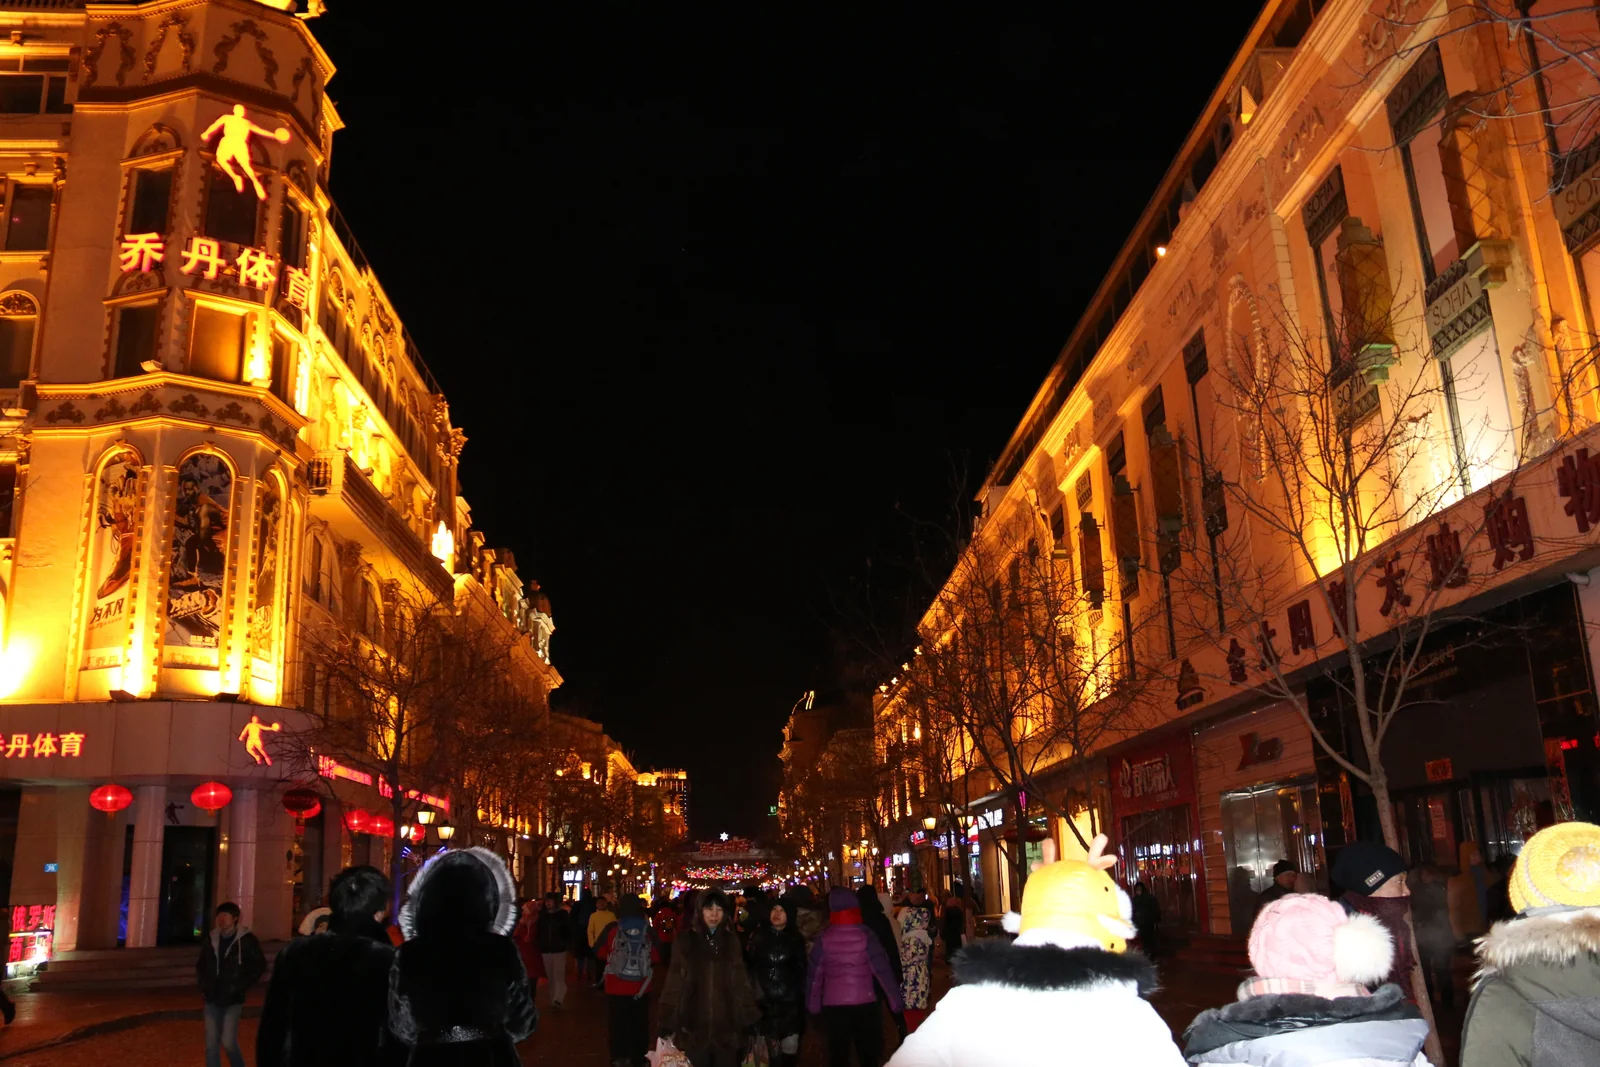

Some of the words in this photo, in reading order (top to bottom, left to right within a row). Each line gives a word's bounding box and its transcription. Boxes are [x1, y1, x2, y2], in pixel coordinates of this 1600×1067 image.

[119, 231, 313, 310] 乔丹体育
[1432, 281, 1473, 326] SOFIA
[1336, 373, 1367, 409] SOIA
[0, 731, 86, 758] 丹体育
[12, 905, 57, 932] 俄罗斯
